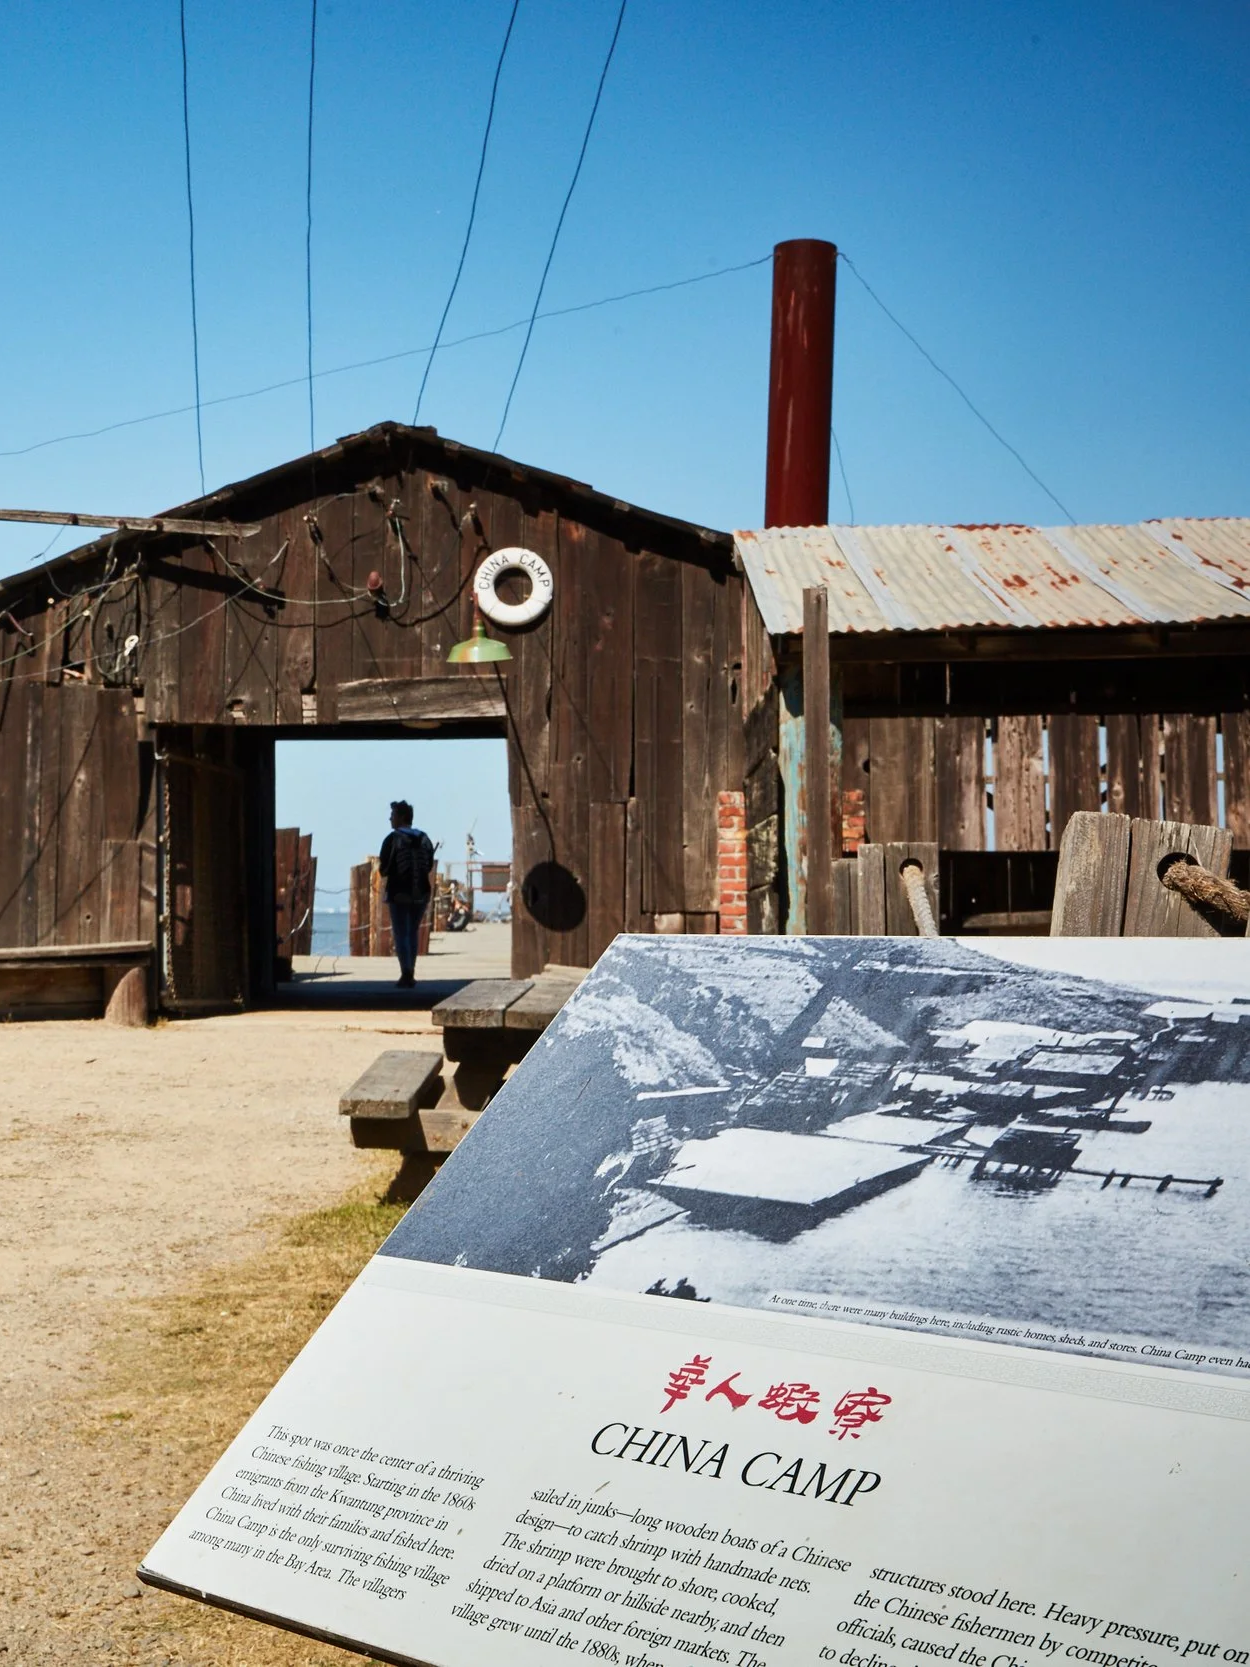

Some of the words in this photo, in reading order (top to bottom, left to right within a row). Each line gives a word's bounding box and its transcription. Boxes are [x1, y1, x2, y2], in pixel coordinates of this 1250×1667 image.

[478, 554, 510, 590] CHINA
[519, 553, 550, 588] CAMP
[769, 1294, 781, 1303] At
[781, 1298, 798, 1306] one
[798, 1299, 818, 1310] time,
[819, 1301, 841, 1312] there
[843, 1306, 863, 1315] were
[863, 1309, 888, 1321] many
[887, 1310, 929, 1326] buildings
[929, 1315, 950, 1329] here,
[951, 1319, 996, 1336] including
[995, 1327, 1023, 1337] rustic
[1023, 1329, 1056, 1343] homes,
[1057, 1333, 1086, 1347] sheds,
[1087, 1339, 1110, 1349] and
[1108, 1343, 1138, 1354] stores.
[1140, 1345, 1173, 1358] China
[1174, 1349, 1207, 1365] Camp
[1208, 1356, 1234, 1366] even
[1235, 1357, 1250, 1369] ha
[251, 1446, 292, 1466] Chinese
[291, 1455, 328, 1478] fishing
[328, 1464, 362, 1485] village.
[362, 1472, 407, 1498] Starting
[405, 1482, 420, 1498] in
[420, 1486, 441, 1502] the
[442, 1491, 476, 1511] 1860s
[267, 1425, 290, 1441] This
[288, 1434, 313, 1448] spot
[313, 1439, 333, 1452] was
[332, 1445, 360, 1458] once
[359, 1447, 379, 1462] the
[379, 1455, 416, 1471] center
[414, 1461, 435, 1475] of
[427, 1467, 437, 1476] a
[437, 1465, 485, 1491] thriving
[591, 1422, 730, 1479] CHINA
[741, 1452, 882, 1507] CAMP
[221, 1486, 252, 1504] China
[251, 1493, 281, 1511] lived
[278, 1504, 303, 1518] with
[302, 1507, 330, 1525] their
[327, 1514, 371, 1537] families
[369, 1528, 397, 1542] and
[391, 1530, 431, 1552] fished
[426, 1539, 455, 1560] here.
[235, 1469, 284, 1488] emigrants
[282, 1477, 310, 1495] from
[309, 1484, 329, 1500] the
[328, 1489, 387, 1518] Kwantung
[381, 1507, 435, 1527] province
[434, 1515, 449, 1531] in
[530, 1488, 570, 1506] sailed
[566, 1493, 582, 1510] in
[664, 1520, 719, 1542] wooden
[720, 1528, 759, 1551] boats
[760, 1540, 785, 1555] of
[777, 1547, 788, 1558] a
[791, 1545, 852, 1572] Chinese
[188, 1530, 225, 1550] among
[223, 1540, 254, 1558] many
[252, 1544, 266, 1559] in
[265, 1548, 285, 1564] the
[283, 1553, 307, 1574] Bay
[304, 1560, 332, 1580] Area.
[337, 1568, 361, 1587] The
[362, 1577, 407, 1600] villagers
[205, 1506, 236, 1525] China
[237, 1515, 268, 1538] Camp
[267, 1523, 279, 1537] is
[278, 1526, 297, 1542] the
[297, 1534, 324, 1553] only
[321, 1542, 374, 1568] surviving
[372, 1552, 413, 1578] fishing
[413, 1564, 450, 1587] village
[501, 1531, 527, 1551] The
[526, 1539, 572, 1566] shrimp
[574, 1554, 606, 1571] were
[606, 1557, 662, 1586] brought
[661, 1575, 678, 1589] to
[678, 1577, 718, 1603] shore,
[721, 1592, 780, 1618] cooked,
[584, 1530, 619, 1546] catch
[619, 1534, 668, 1562] shrimp
[670, 1549, 702, 1566] with
[702, 1552, 778, 1584] handmade
[778, 1576, 811, 1594] nets.
[451, 1603, 490, 1627] village
[486, 1617, 525, 1634] grew
[524, 1626, 559, 1644] until
[556, 1631, 579, 1650] the
[580, 1638, 620, 1666] 1880s,
[465, 1578, 518, 1603] shipped
[514, 1594, 530, 1607] to
[528, 1595, 558, 1615] Asia
[557, 1607, 588, 1622] and
[585, 1613, 624, 1633] other
[622, 1620, 672, 1649] foreign
[672, 1639, 730, 1664] markets.
[483, 1555, 521, 1576] dried
[517, 1568, 536, 1581] on
[536, 1573, 546, 1584] a
[542, 1572, 602, 1599] platform
[604, 1591, 622, 1603] or
[620, 1590, 670, 1616] hillside
[669, 1608, 720, 1633] nearby,
[719, 1621, 753, 1637] and
[750, 1625, 785, 1647] then
[853, 1590, 880, 1609] the
[884, 1597, 949, 1626] Chinese
[950, 1612, 1036, 1648] fishermen
[1038, 1632, 1064, 1658] by
[869, 1568, 947, 1595] structures
[947, 1585, 999, 1606] stood
[996, 1591, 1036, 1616] here.
[1042, 1602, 1104, 1635] Heavy
[1099, 1621, 1180, 1652] pressure,
[1179, 1639, 1221, 1658] put
[1223, 1648, 1250, 1665] on
[818, 1645, 837, 1660] to
[836, 1618, 896, 1649] officials,
[901, 1637, 960, 1660] caused
[958, 1646, 987, 1667] the
